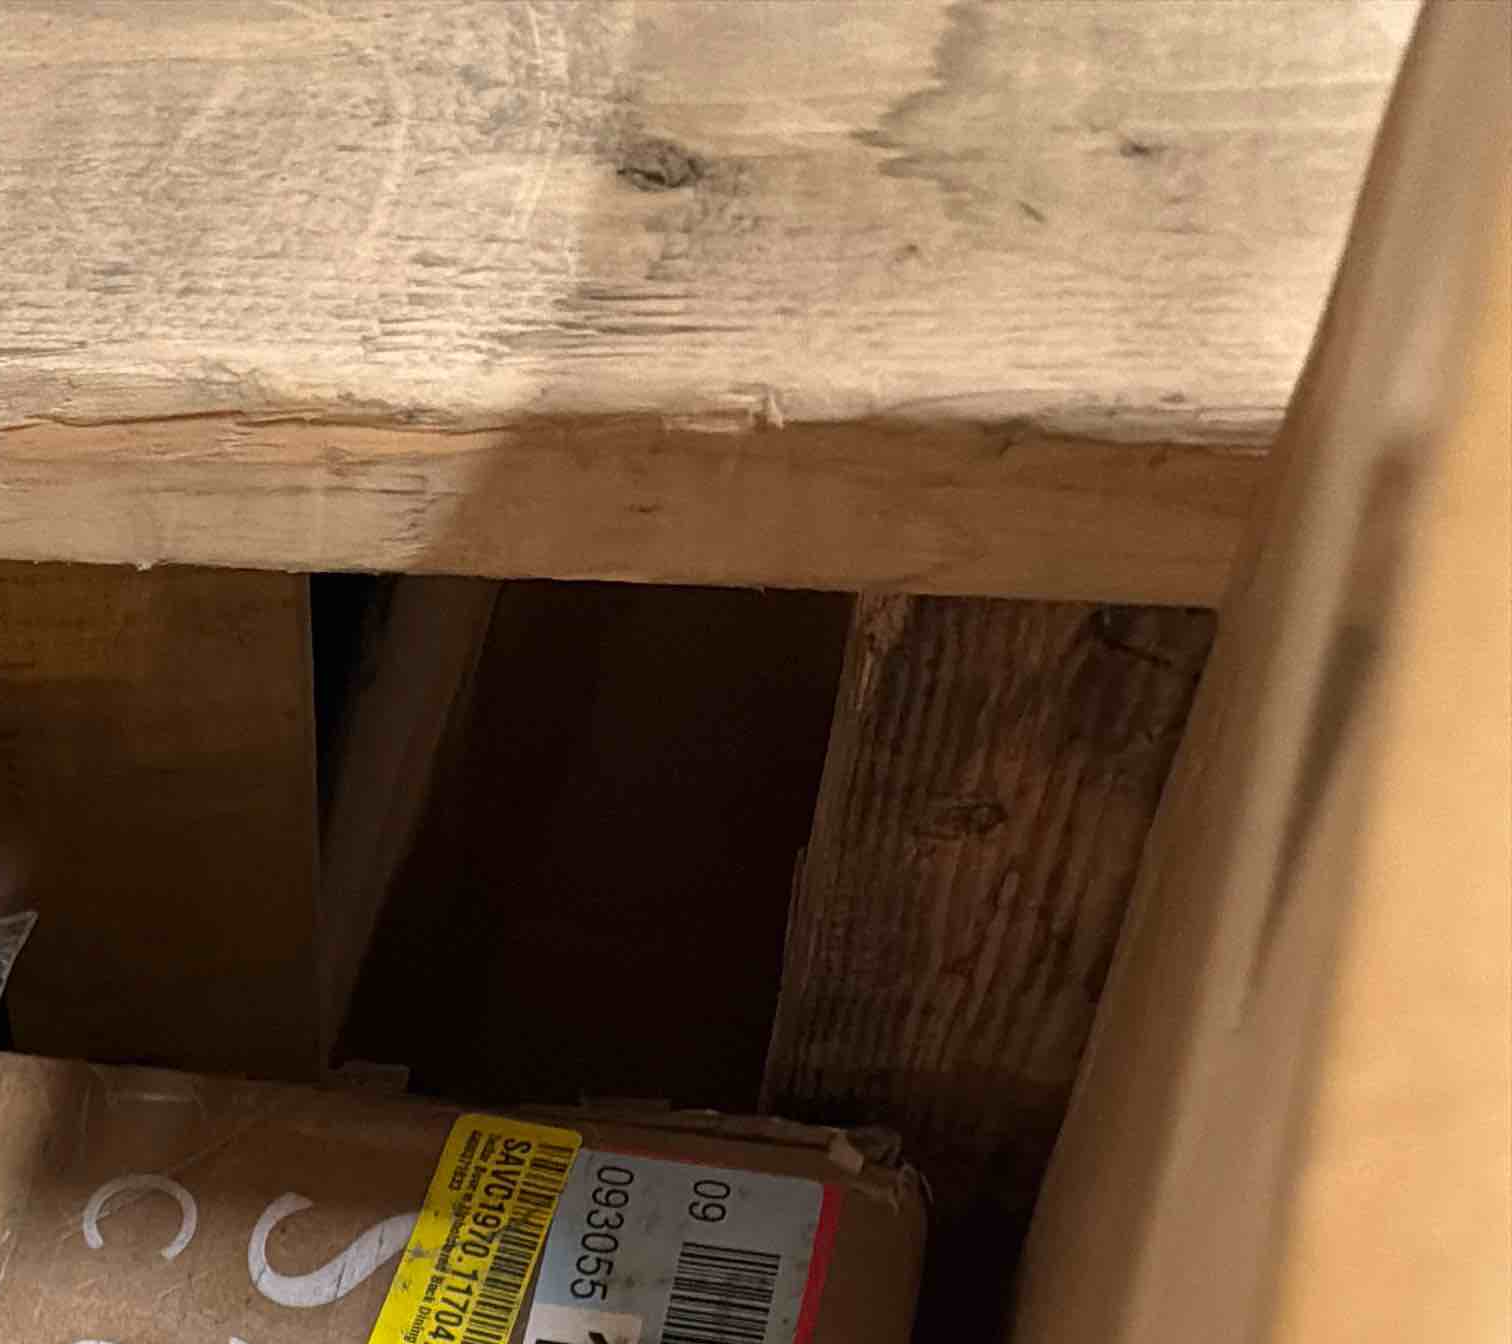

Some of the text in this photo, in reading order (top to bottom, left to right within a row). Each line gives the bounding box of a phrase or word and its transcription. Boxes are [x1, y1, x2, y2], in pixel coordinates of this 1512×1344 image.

[688, 1178, 731, 1225] 09
[570, 1165, 634, 1301] 093055
[403, 1304, 430, 1344] Dining
